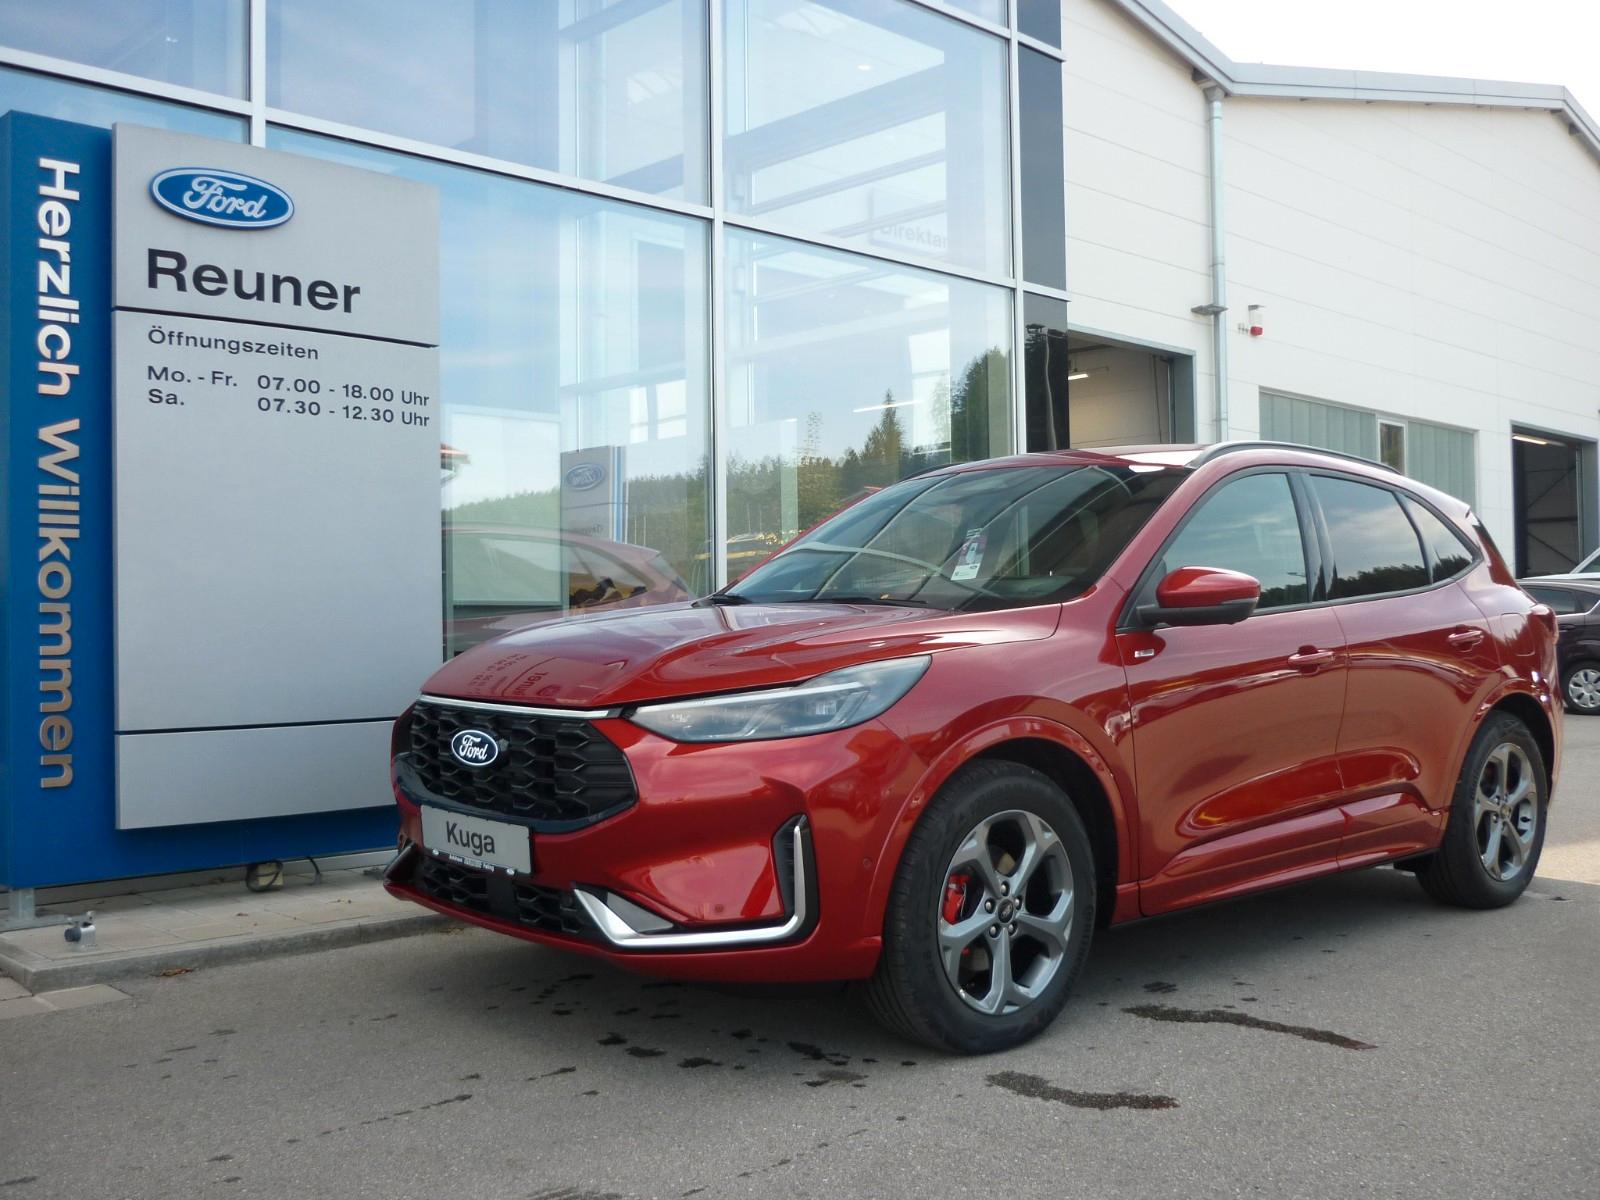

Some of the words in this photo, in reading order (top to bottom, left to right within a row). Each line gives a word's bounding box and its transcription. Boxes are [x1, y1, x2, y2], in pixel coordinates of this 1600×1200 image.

[182, 176, 268, 220] Ford
[37, 157, 80, 396] Herzlich
[147, 248, 361, 314] Reuner
[147, 325, 319, 360] Öffnungszeiten
[147, 365, 191, 383] Mo.
[211, 370, 238, 387] Fr.
[257, 375, 321, 395] 07.00
[341, 384, 394, 402] 18.00
[401, 390, 430, 406] Uhr
[148, 388, 185, 406] Sa.
[257, 397, 321, 416] 07.30
[341, 405, 394, 423] 12.30
[401, 411, 430, 427] Uhr
[37, 418, 80, 789] Willkommen
[458, 734, 488, 761] Ford
[446, 820, 496, 857] Kuga
